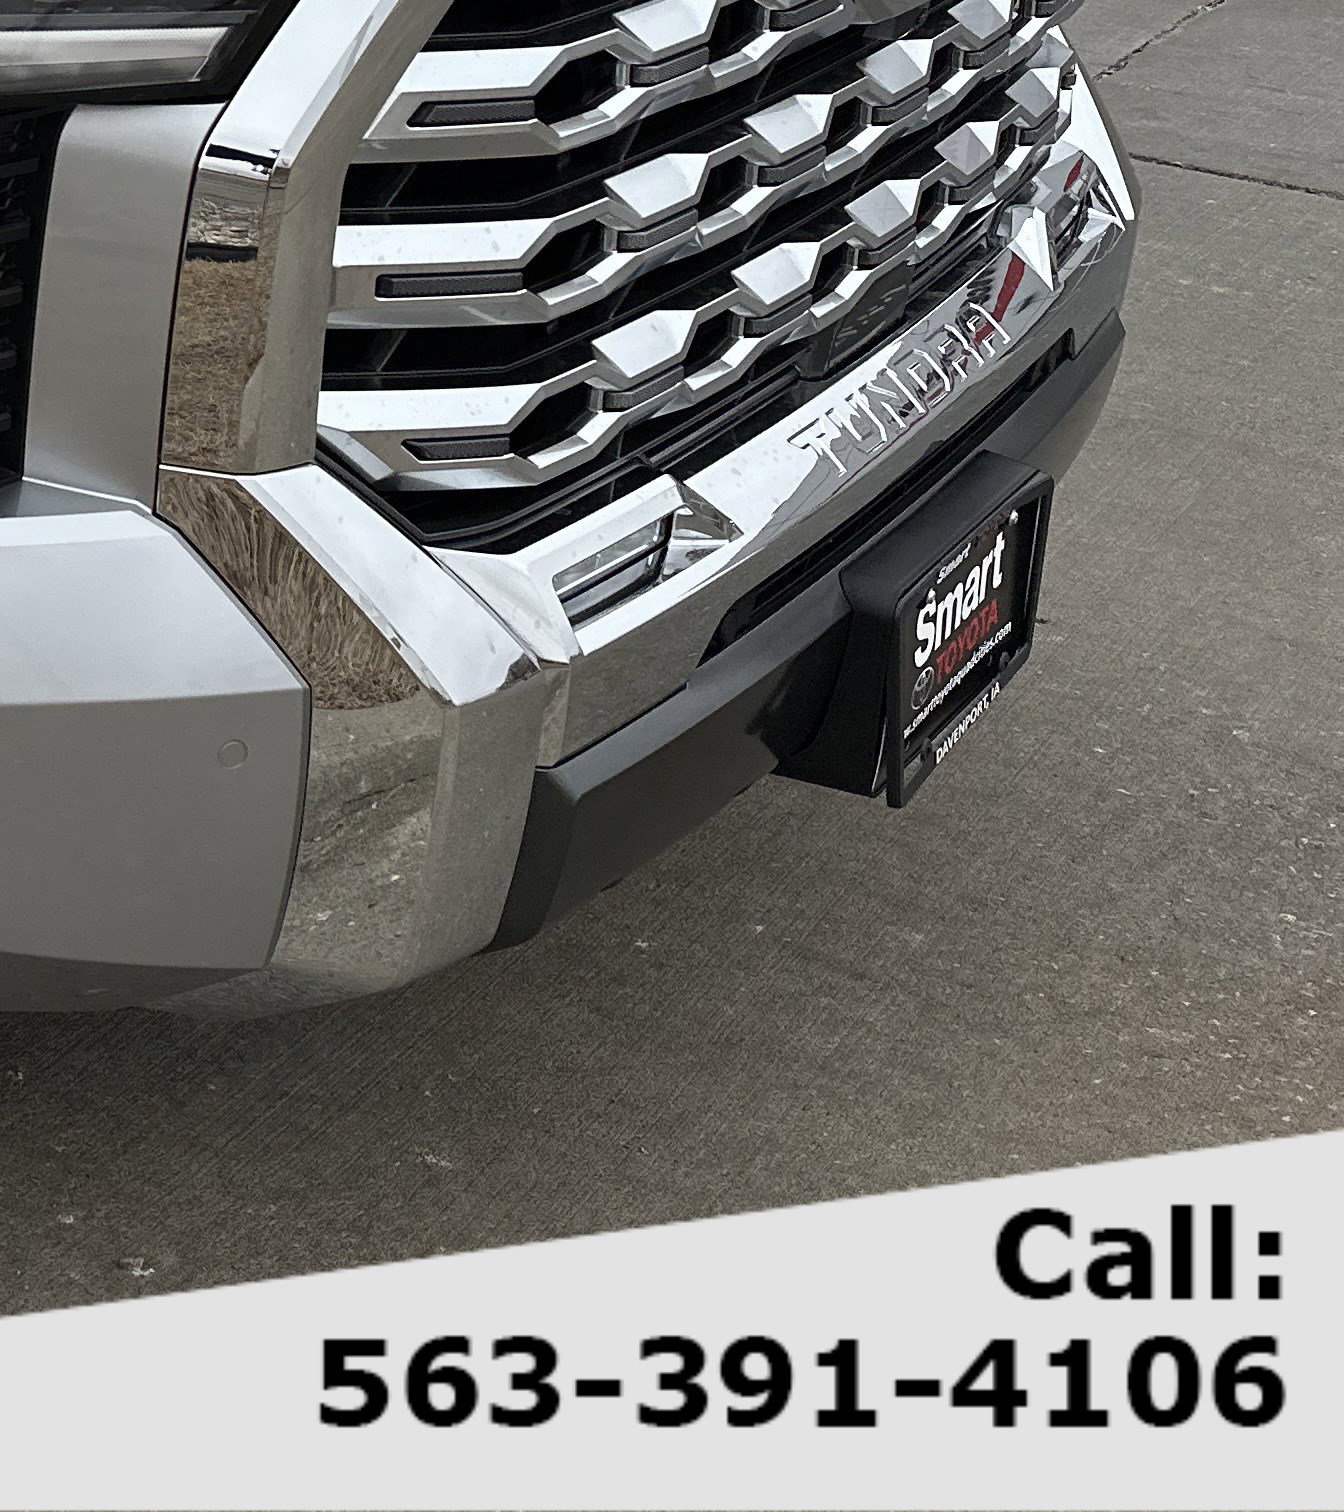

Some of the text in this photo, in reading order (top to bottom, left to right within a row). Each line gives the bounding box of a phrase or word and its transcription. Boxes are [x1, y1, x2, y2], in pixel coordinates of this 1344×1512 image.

[787, 301, 1011, 477] TUNDRA
[914, 530, 1006, 668] Smart
[936, 599, 999, 685] TOYOTA
[935, 681, 1001, 765] DAVENPORT, IA
